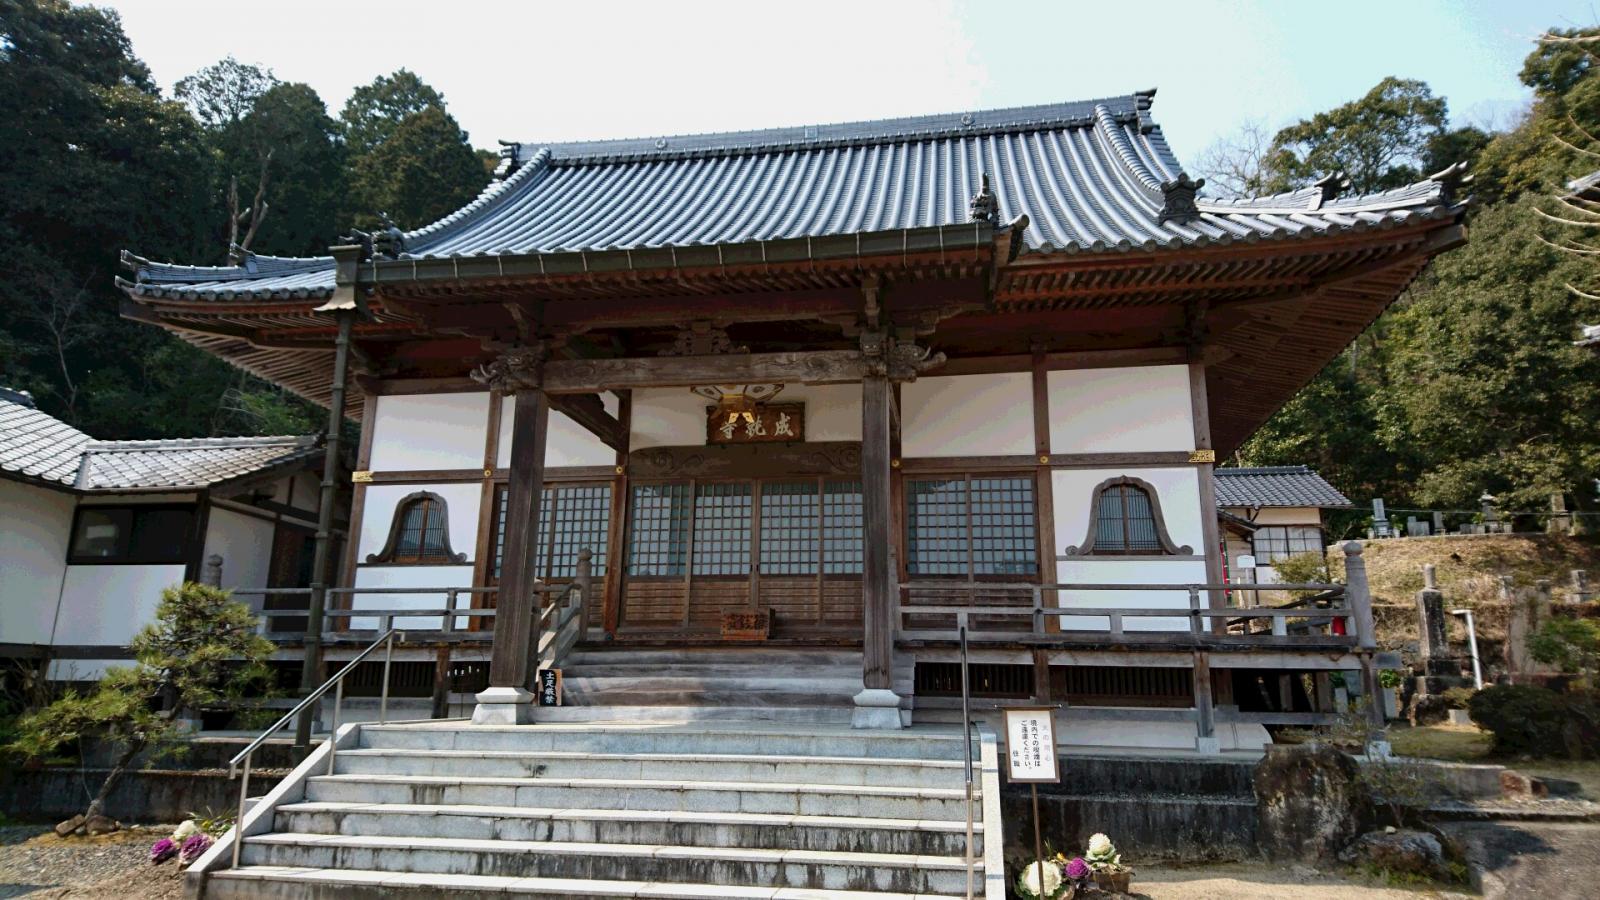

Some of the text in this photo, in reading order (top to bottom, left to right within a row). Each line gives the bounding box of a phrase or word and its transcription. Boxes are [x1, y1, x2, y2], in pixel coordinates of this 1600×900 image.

[1030, 719, 1041, 767] 境内での喫煙は
